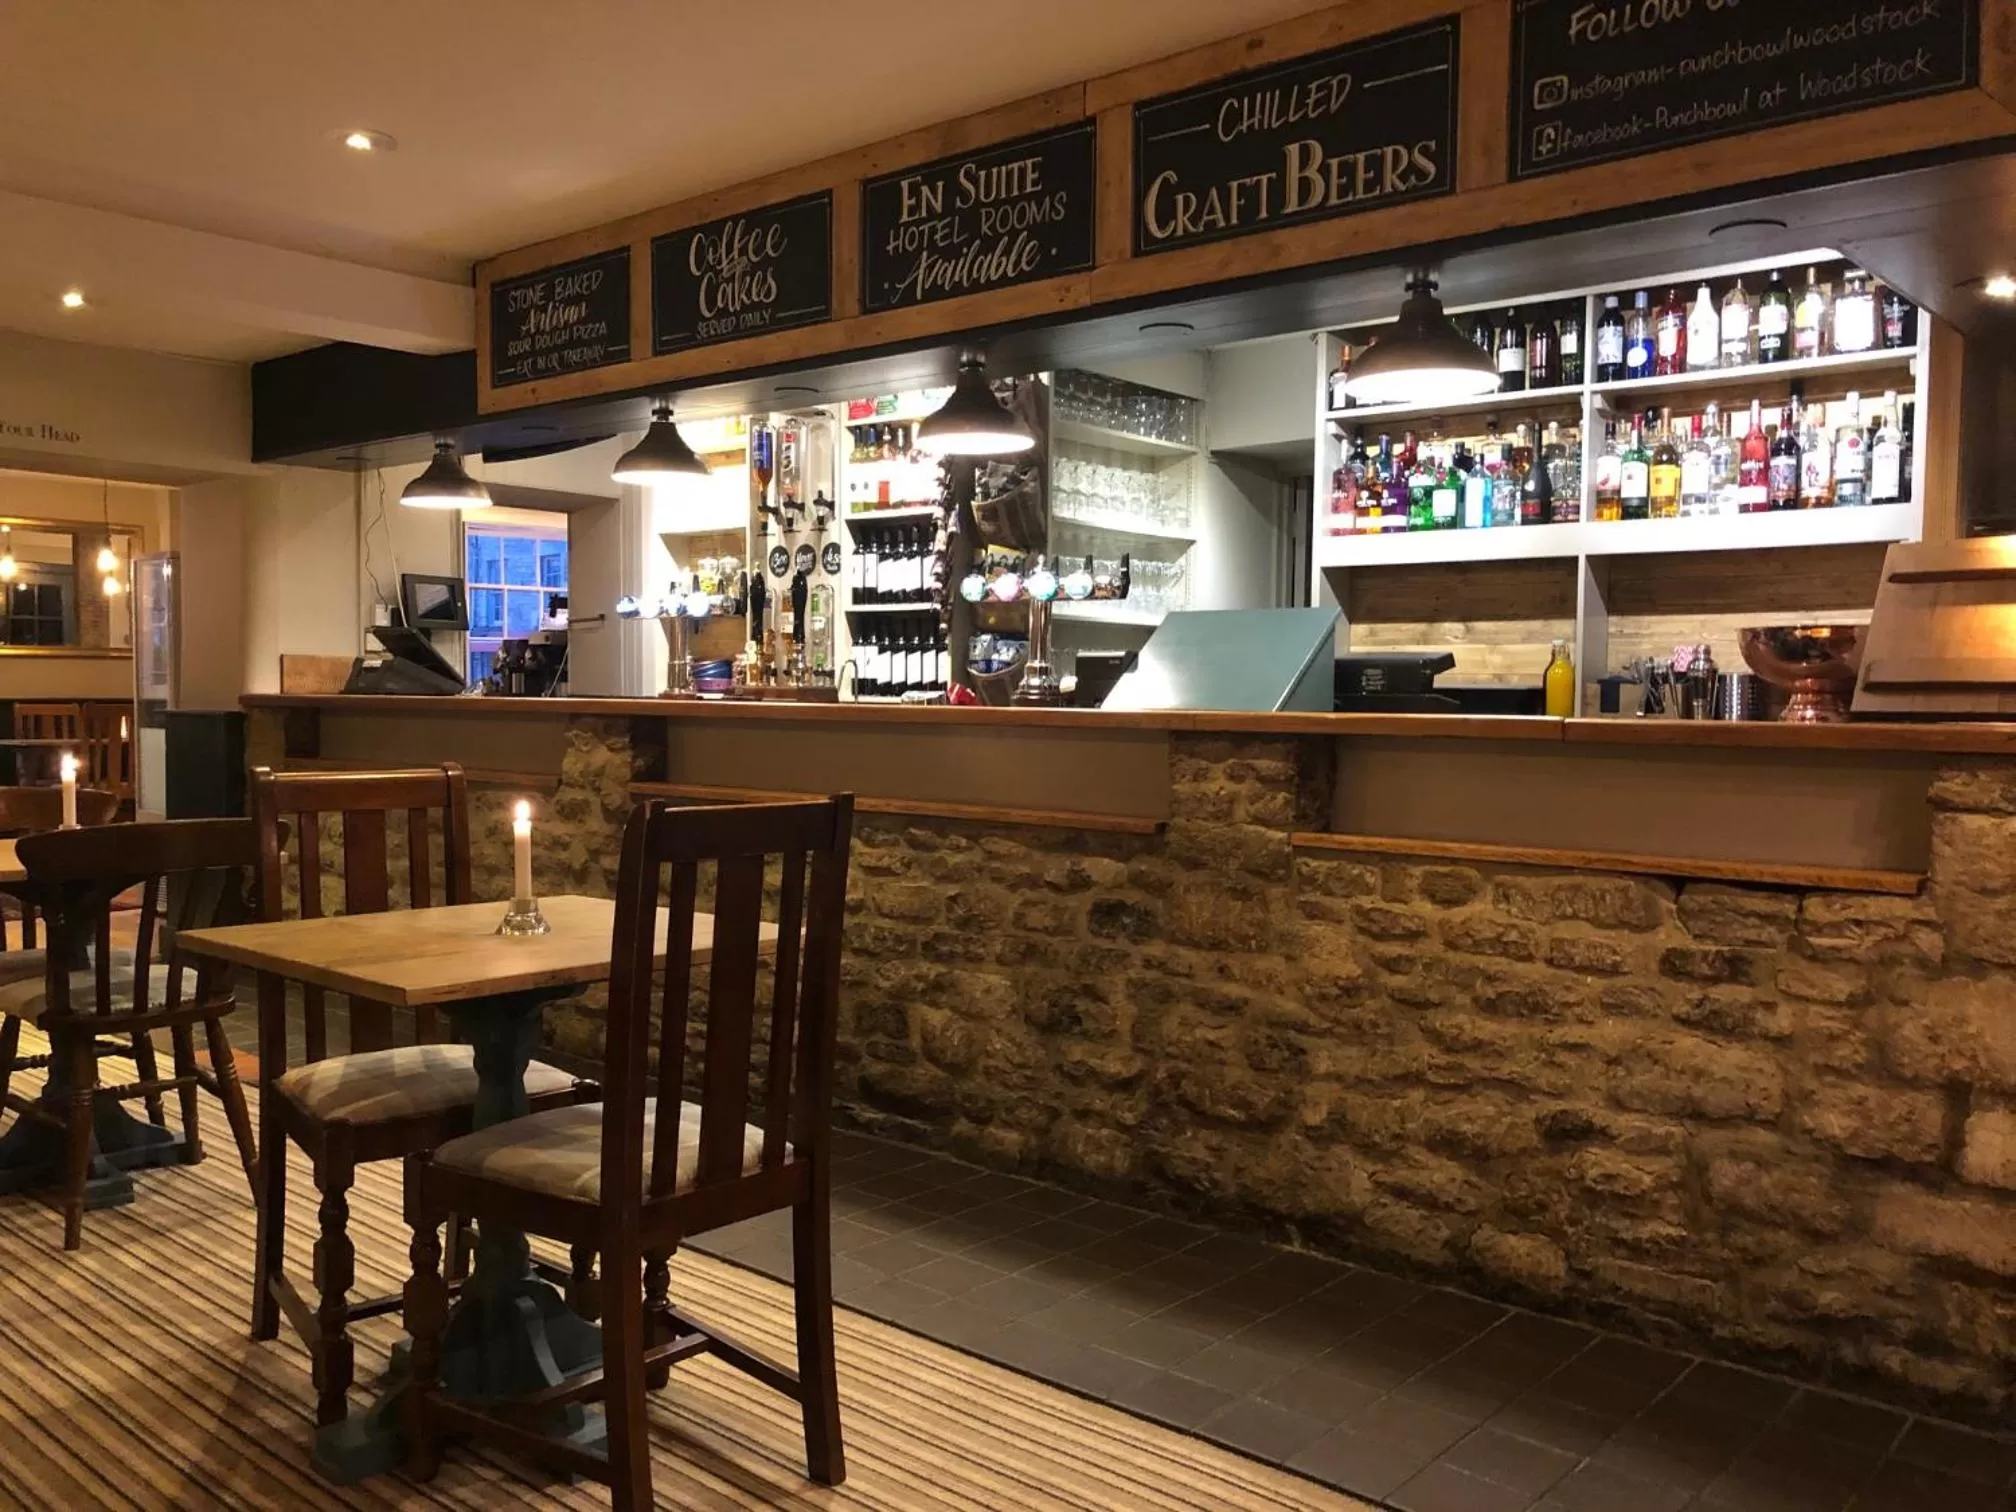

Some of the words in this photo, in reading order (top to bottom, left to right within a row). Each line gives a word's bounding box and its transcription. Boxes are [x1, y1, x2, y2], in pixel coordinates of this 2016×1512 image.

[1568, 0, 1690, 44] FOLLOW
[1217, 73, 1352, 143] CHILLED
[1759, 80, 1787, 108] at
[899, 175, 945, 223] EN
[956, 156, 1043, 209] SUITE
[1143, 170, 1277, 239] CRAFT
[1280, 139, 1438, 214] BEERS
[689, 218, 788, 277] Coffee
[886, 216, 968, 255] HOTEL
[980, 191, 1067, 237] ROOMS
[508, 282, 548, 312] STONE
[554, 269, 604, 301] BAKED
[699, 265, 778, 318] Cakes
[890, 230, 1041, 304] Available
[507, 337, 532, 356] SOUR
[535, 329, 571, 349] DOUGH
[573, 321, 607, 340] PIZZA
[697, 316, 736, 339] SERVED
[739, 308, 772, 326] DAILY
